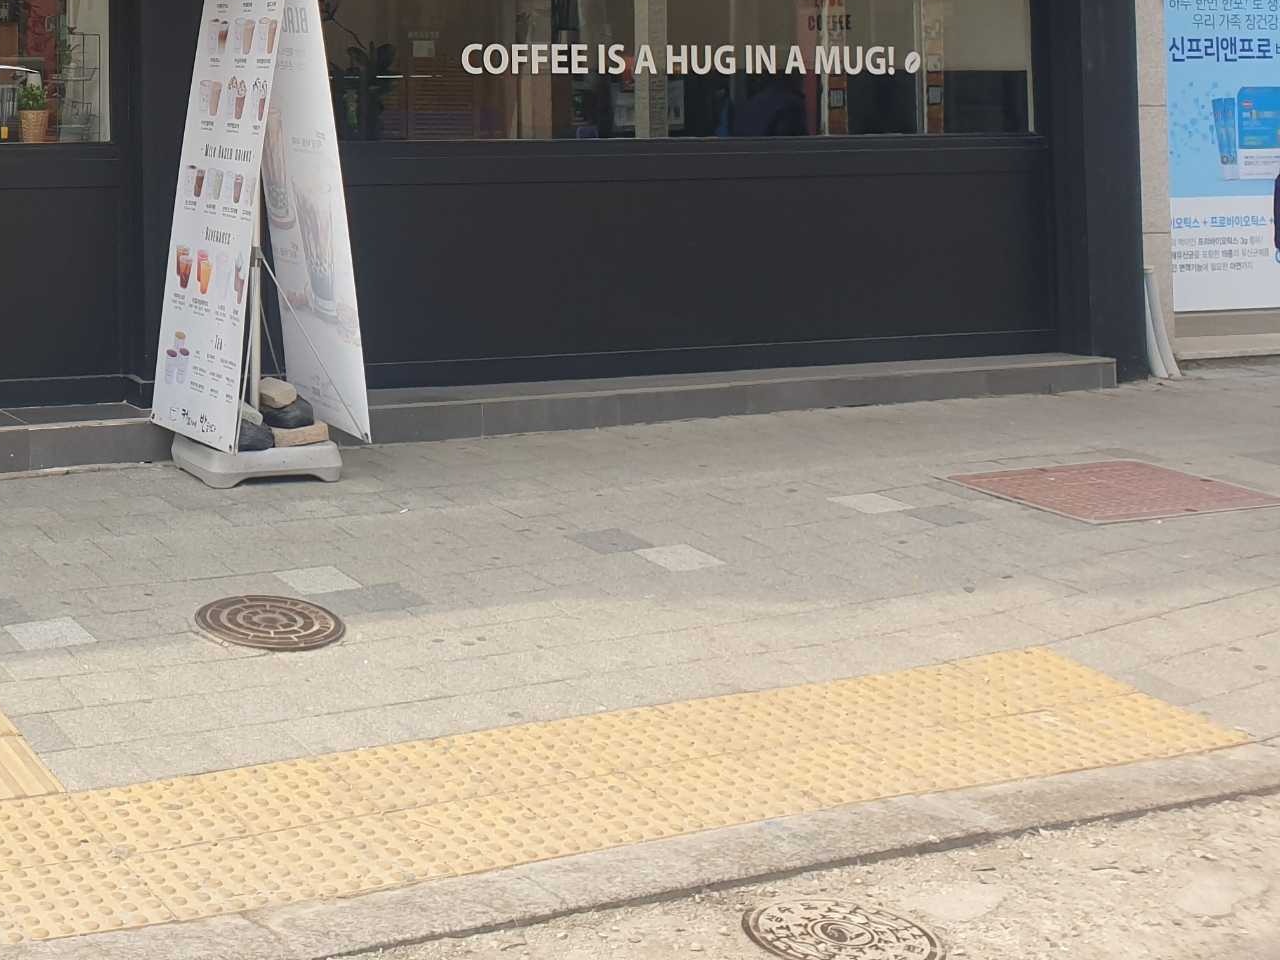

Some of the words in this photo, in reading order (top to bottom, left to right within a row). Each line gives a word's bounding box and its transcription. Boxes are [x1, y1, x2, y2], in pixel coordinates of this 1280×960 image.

[1192, 13, 1215, 30] 우리
[1218, 13, 1241, 30] 가족
[461, 44, 588, 75] COFFEE
[598, 44, 626, 75] IS
[634, 44, 658, 75] A
[666, 44, 736, 75] HUG
[745, 44, 777, 75] IN
[785, 44, 807, 75] A
[814, 44, 896, 75] MUG!
[1168, 36, 1274, 63] 신프리앤프로
